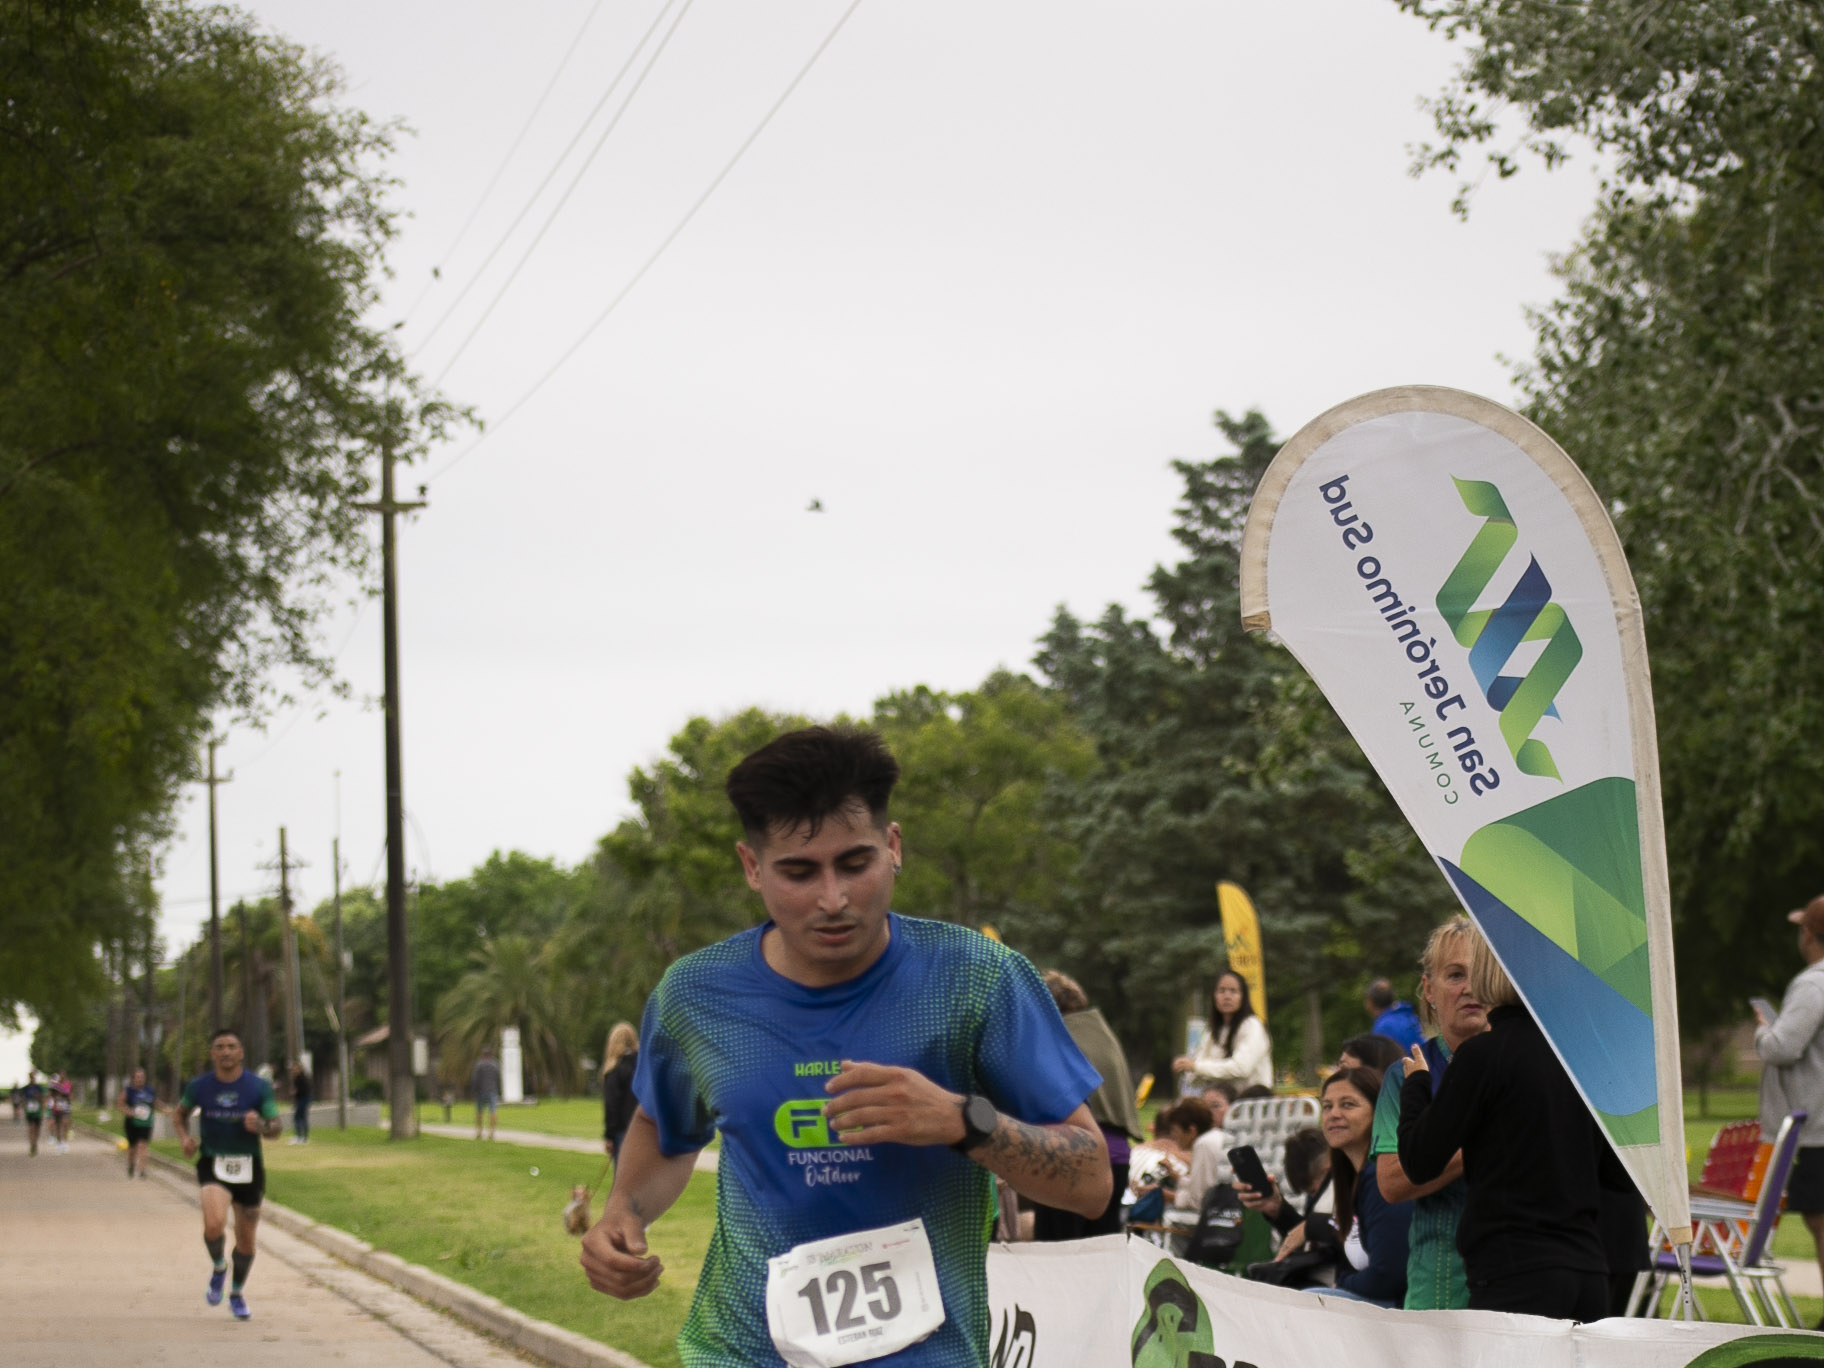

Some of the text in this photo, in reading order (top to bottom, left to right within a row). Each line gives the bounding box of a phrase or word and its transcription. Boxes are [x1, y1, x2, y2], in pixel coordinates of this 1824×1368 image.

[795, 1060, 847, 1077] HARLE
[788, 1148, 874, 1165] FUNCIONAL
[805, 1165, 861, 1187] Outdoor
[798, 1261, 902, 1336] 125
